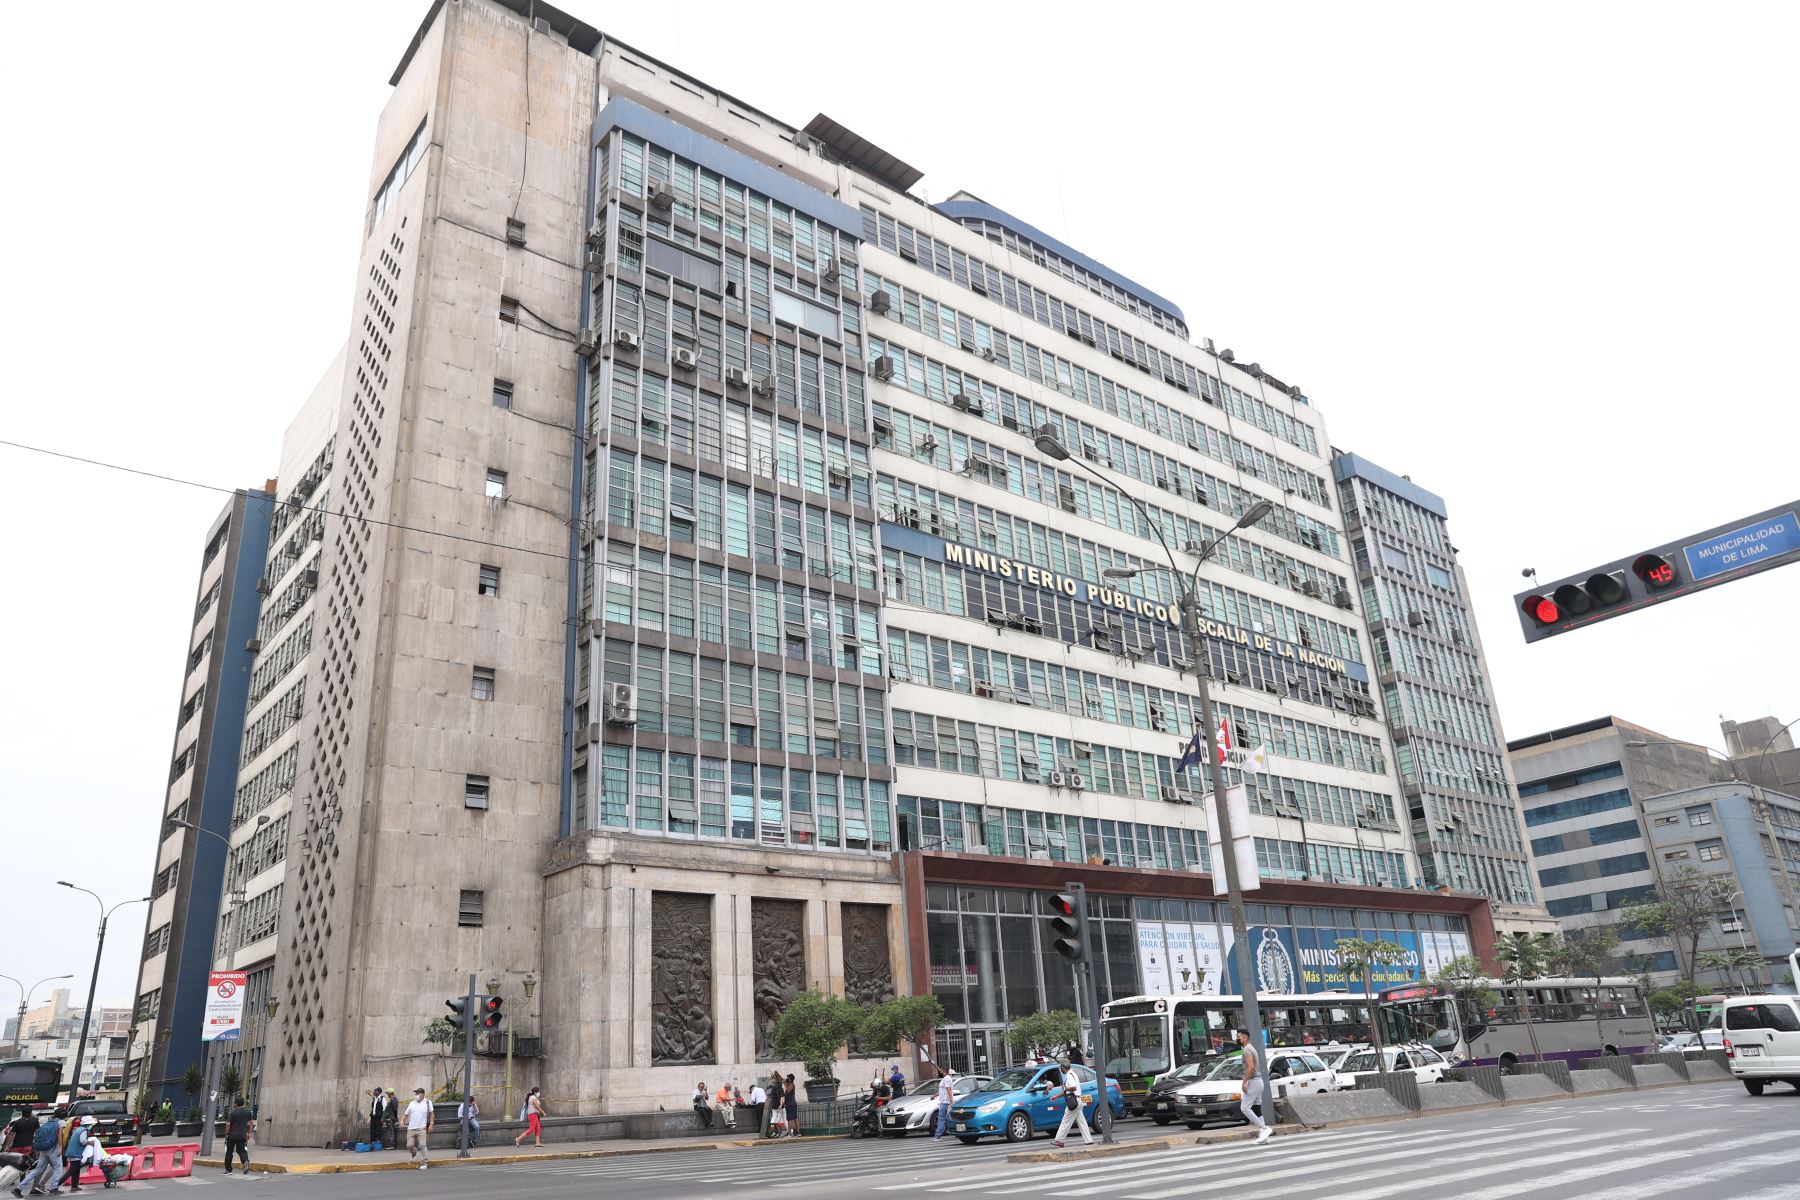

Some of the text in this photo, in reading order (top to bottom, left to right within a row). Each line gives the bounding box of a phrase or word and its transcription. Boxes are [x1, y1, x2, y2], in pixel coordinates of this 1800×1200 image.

[1698, 524, 1785, 559] MUNICIPALIDAD
[1722, 543, 1768, 564] DE LIMA
[945, 542, 1168, 623] MINISTERIO PÚBLICO
[1649, 563, 1673, 583] 45
[1254, 633, 1273, 652] DE
[1276, 640, 1295, 659] LA
[1298, 645, 1346, 674] NACIÓN
[1140, 940, 1158, 949] PARA
[1200, 942, 1220, 950] SALUD
[1303, 970, 1321, 983] Más
[1154, 1000, 1165, 1013] C
